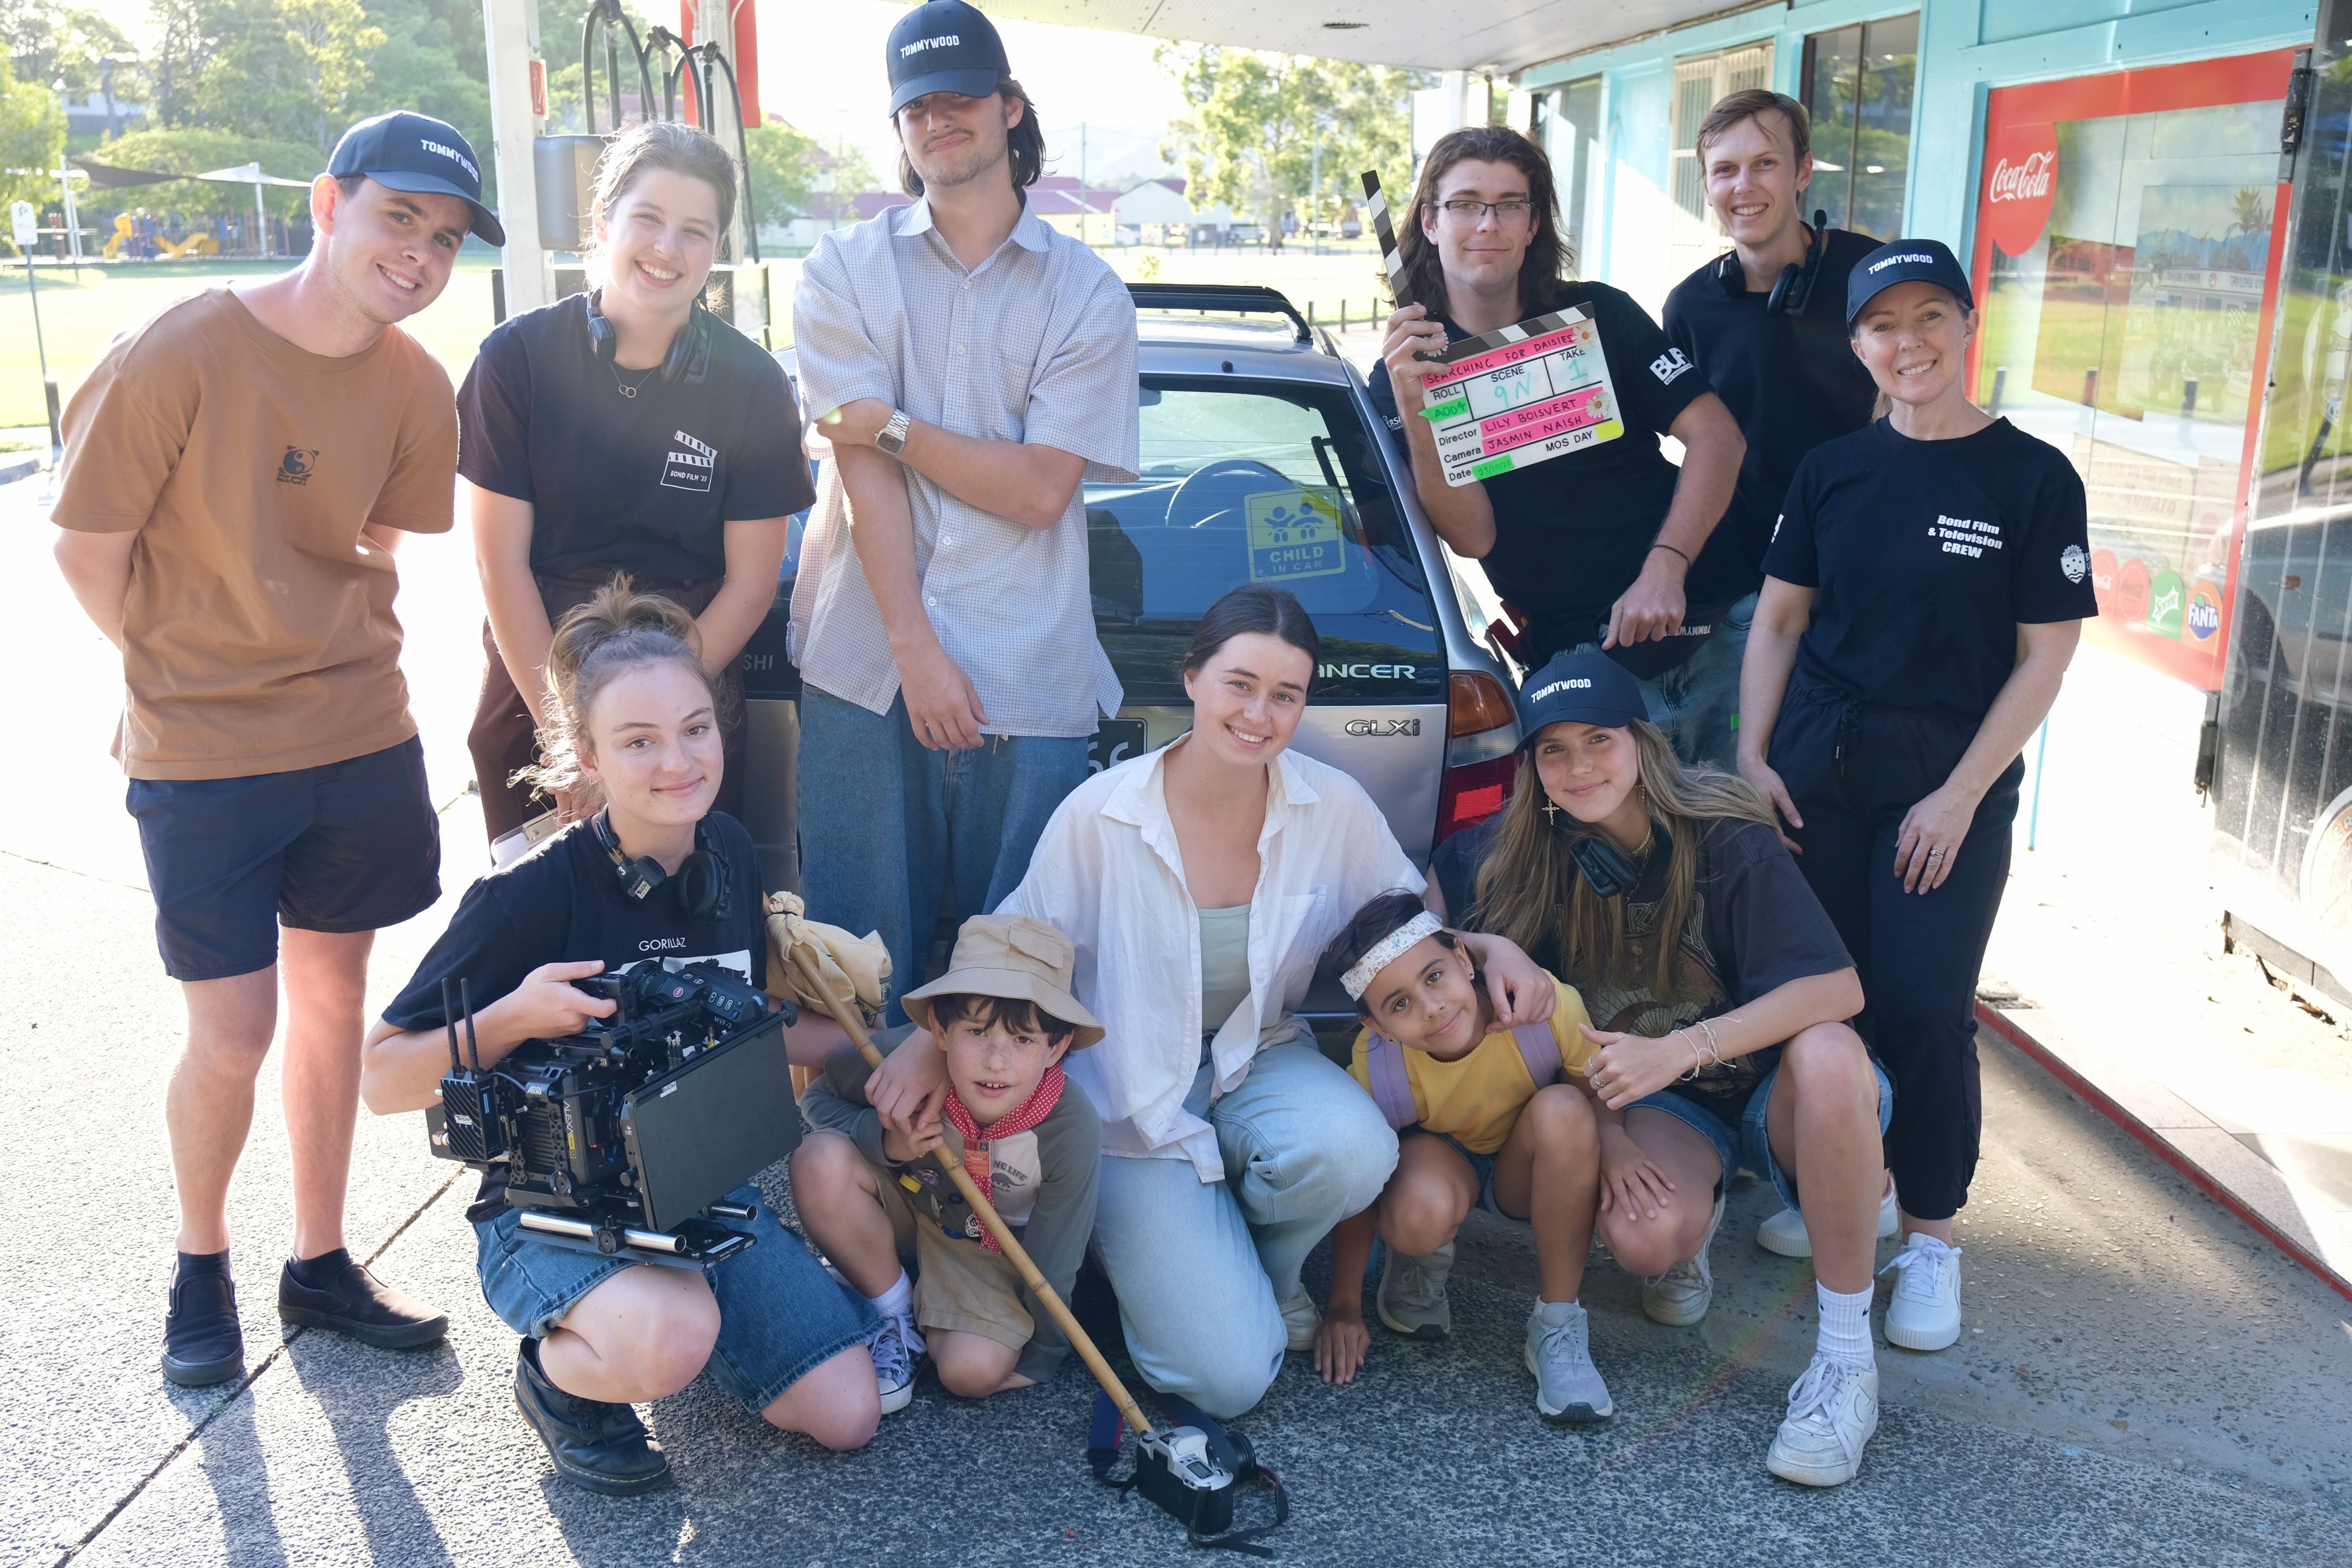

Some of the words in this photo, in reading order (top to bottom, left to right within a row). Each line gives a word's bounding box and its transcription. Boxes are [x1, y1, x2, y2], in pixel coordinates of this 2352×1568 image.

[900, 34, 960, 59] TOMMYWOOD
[420, 139, 479, 183] TOMMYWOOD
[1868, 254, 1933, 275] TOMMYWOOD
[1505, 349, 1526, 362] FOR
[1534, 334, 1573, 352] DAISIES
[1559, 349, 1586, 361] TAKE
[1491, 365, 1525, 382] SCENE
[1568, 358, 1588, 381] 1
[1433, 386, 1461, 401] ROLL
[1434, 401, 1466, 419] A004
[1485, 417, 1510, 432] LILY
[1518, 399, 1576, 423] BOISVERT
[1438, 429, 1477, 446] Director
[1487, 431, 1533, 450] JASMIN
[1543, 415, 1583, 433] NAISH
[1545, 438, 1569, 452] MOS
[1573, 430, 1593, 444] DAY
[1444, 447, 1481, 463] Camera
[670, 470, 686, 478] BOND
[686, 473, 699, 481] FILM
[1448, 469, 1472, 481] Date
[1937, 514, 1971, 529] Bond
[1972, 521, 2000, 535] Film
[1927, 527, 1936, 536] &
[1939, 527, 2003, 549] Television
[1270, 546, 1324, 563] CHILD
[1942, 541, 1983, 558] CREW
[1273, 564, 1286, 573] IN
[1293, 560, 1322, 571] CAR
[2188, 603, 2218, 628] FANTA
[1664, 624, 1711, 637] TOMMYW
[742, 653, 773, 671] SHI
[1318, 664, 1415, 679] NCER
[1531, 678, 1592, 703] TOMMYWOOD
[1345, 718, 1421, 735] GLXi
[618, 866, 626, 876] 3
[639, 937, 687, 951] GORILLAZ
[714, 1016, 732, 1029] MVF-2
[527, 1086, 542, 1095] ARRI
[563, 1101, 574, 1136] ALEXA
